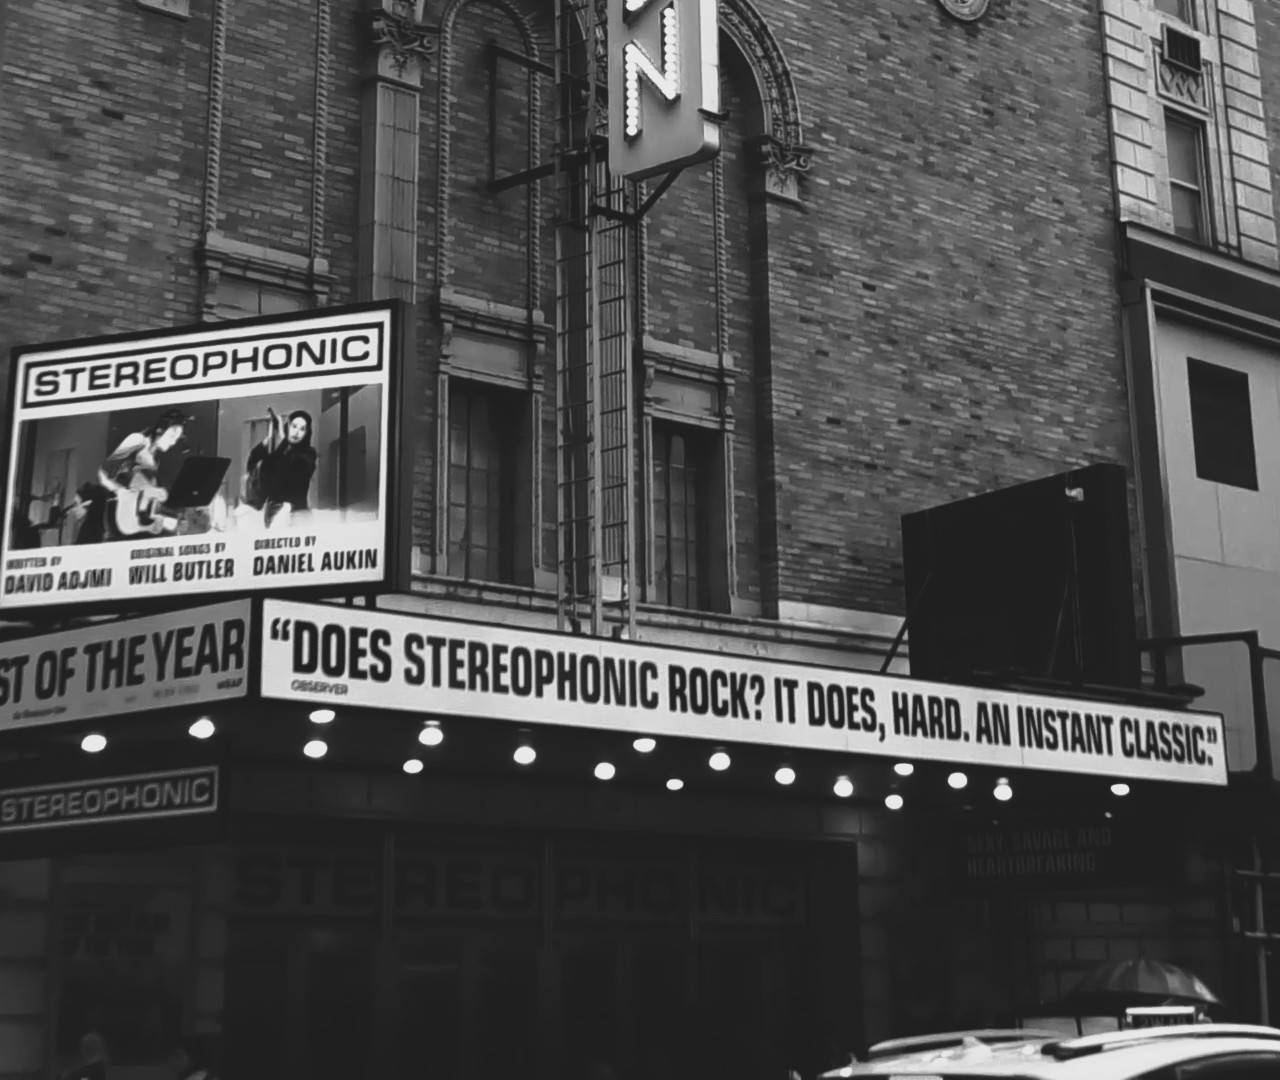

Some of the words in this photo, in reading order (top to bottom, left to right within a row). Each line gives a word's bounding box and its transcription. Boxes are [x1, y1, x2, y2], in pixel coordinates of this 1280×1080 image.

[33, 334, 371, 397] STEREOPHONIC
[254, 536, 302, 551] DIRECTED
[305, 535, 317, 547] BY
[128, 563, 170, 586] WILL
[173, 558, 235, 580] BUTLER
[253, 552, 315, 576] DANIEL
[320, 548, 378, 571] AUKIN
[4, 570, 54, 595] DAVID
[57, 567, 112, 590] ADJMI
[35, 647, 78, 700] OF
[82, 634, 148, 693] THE
[151, 618, 245, 682] YEAR
[290, 679, 349, 695] OBSERVER
[403, 633, 659, 710] STEREOPHONIC
[668, 664, 766, 720] ROCK?
[774, 677, 800, 724] IT
[807, 682, 886, 743] DOES,
[891, 691, 970, 742] HARD.
[976, 701, 1011, 747] AN
[1017, 705, 1114, 757] INSTANT
[1, 777, 210, 822] STEREOPHONIC
